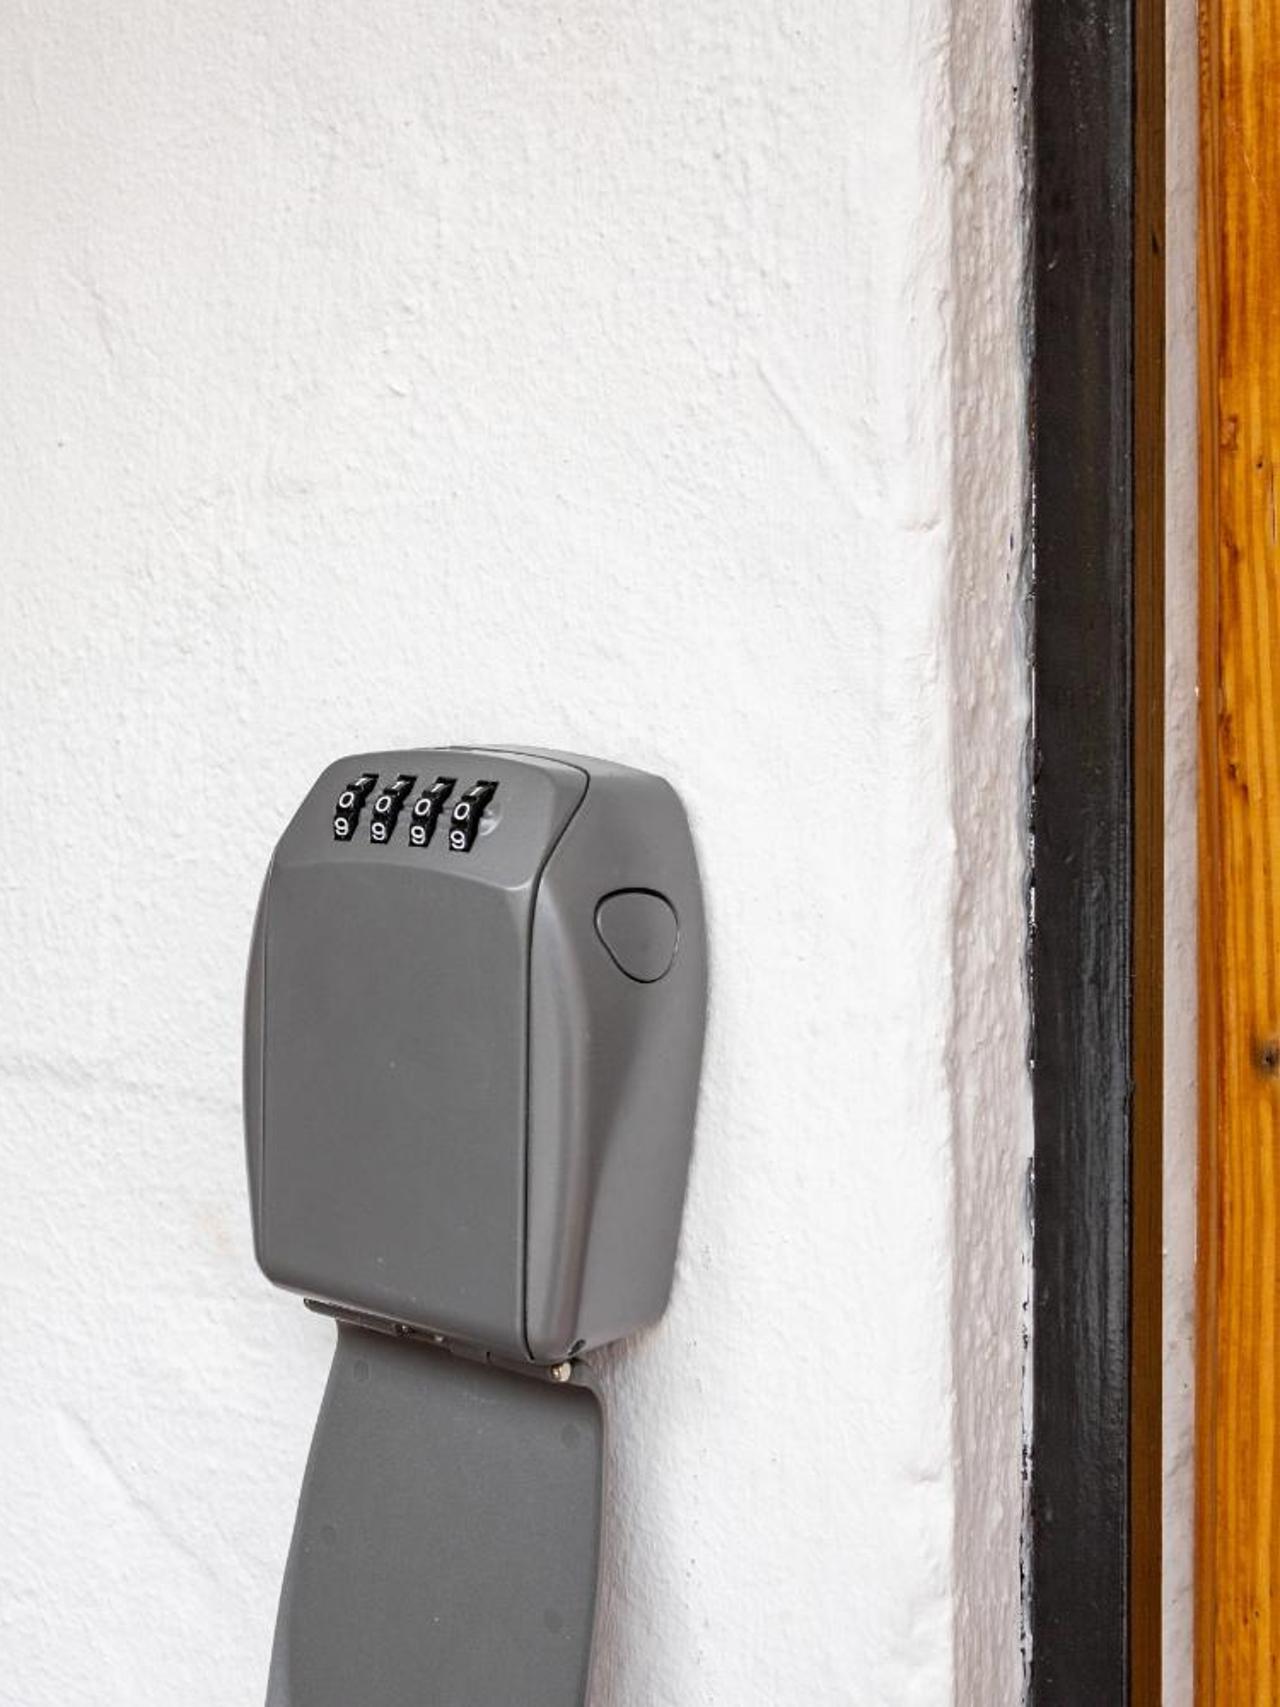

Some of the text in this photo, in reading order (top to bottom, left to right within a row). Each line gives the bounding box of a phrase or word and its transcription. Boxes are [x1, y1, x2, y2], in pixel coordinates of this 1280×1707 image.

[338, 791, 470, 820] 0 0 0 0
[334, 817, 465, 849] 9 9 9 9
